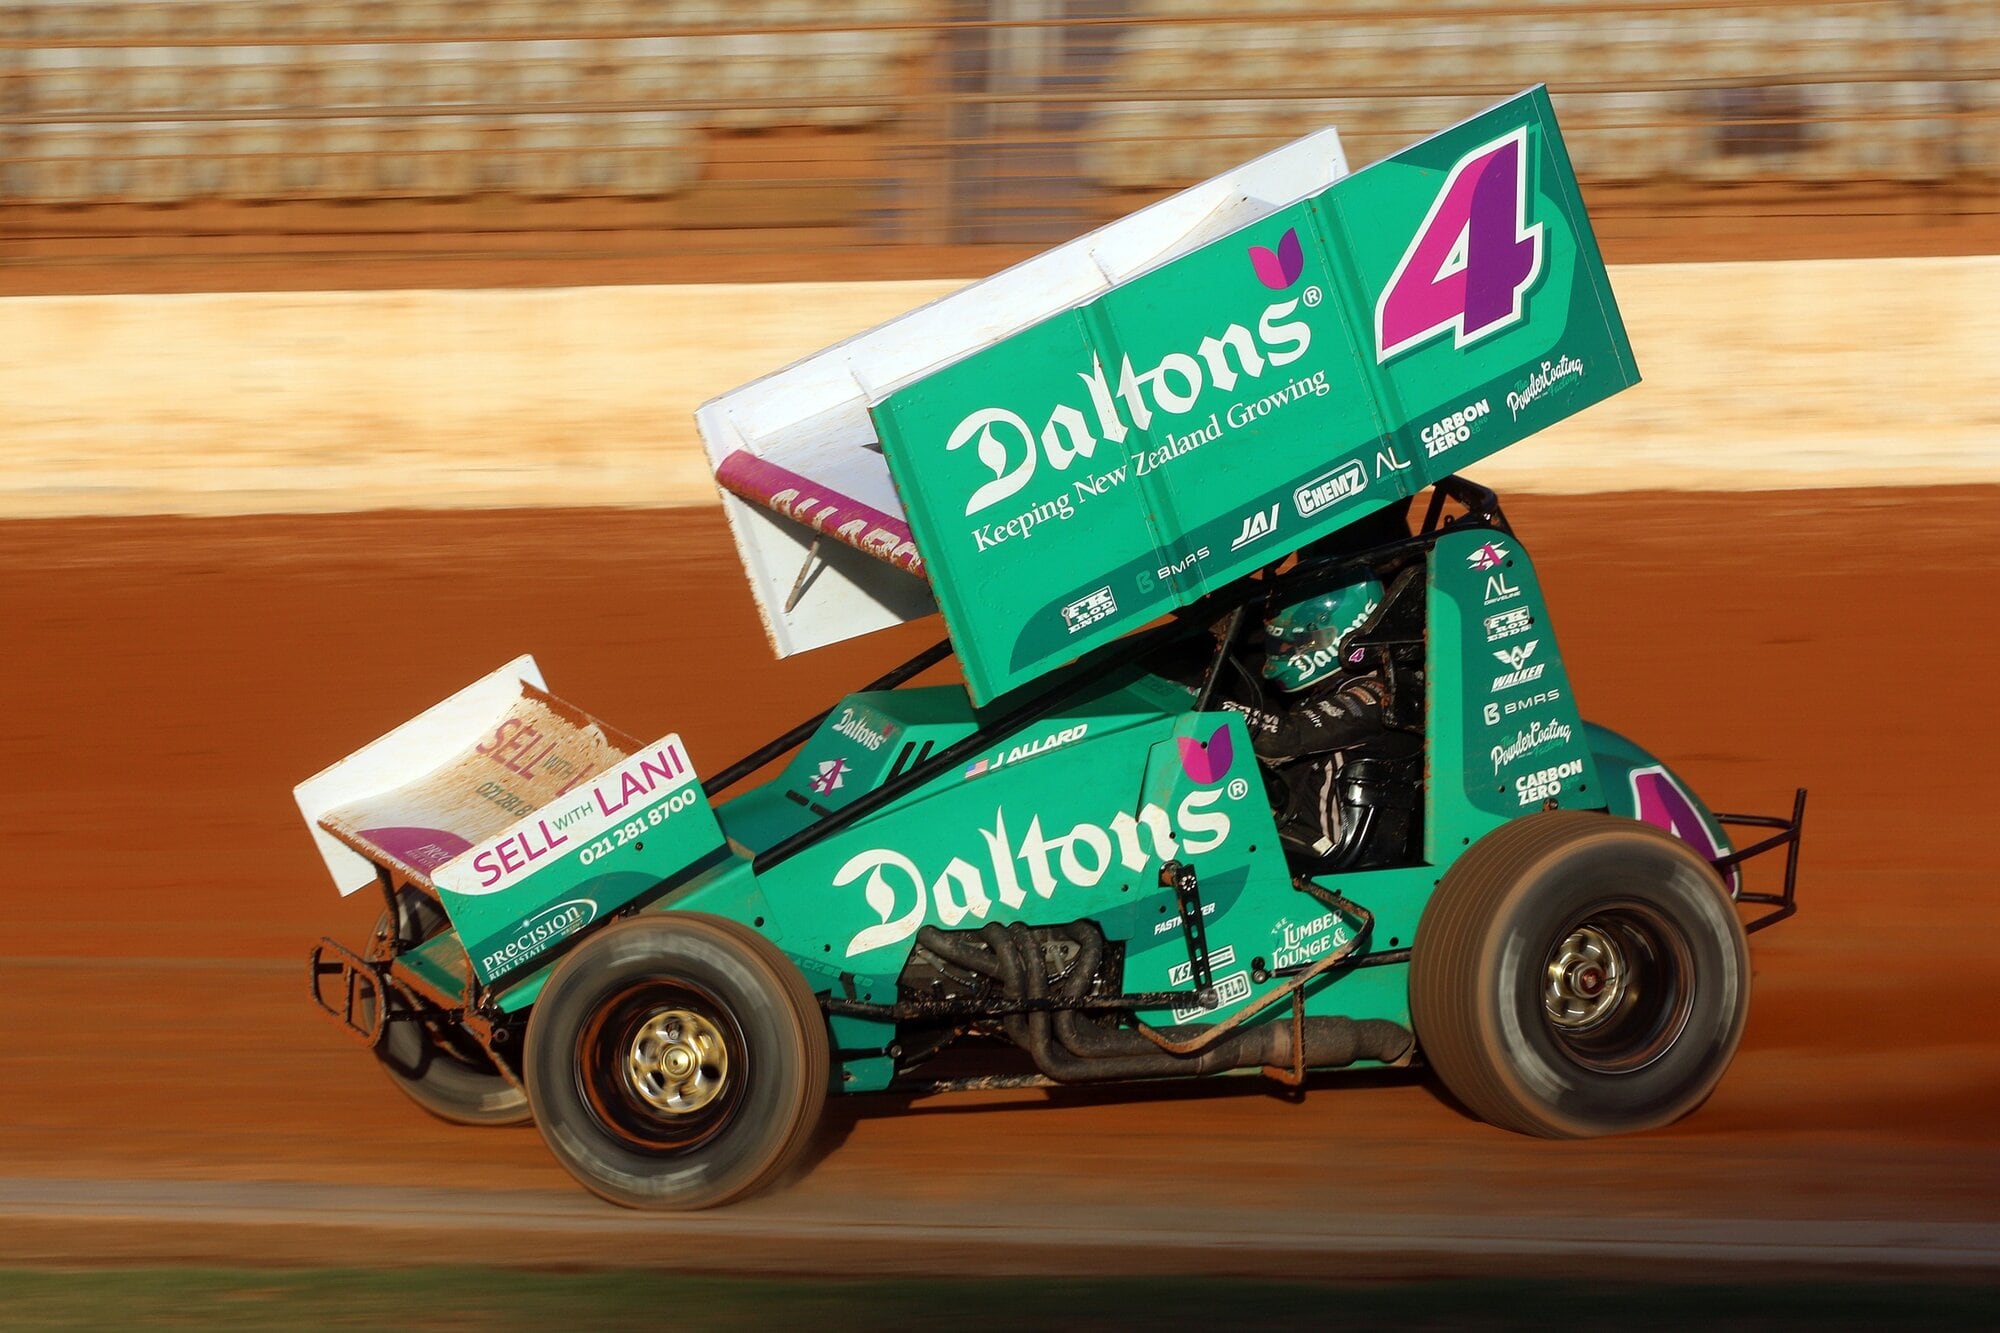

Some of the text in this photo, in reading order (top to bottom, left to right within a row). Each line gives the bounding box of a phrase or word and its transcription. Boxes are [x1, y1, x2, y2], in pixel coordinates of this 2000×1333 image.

[1375, 125, 1543, 365] 4
[1420, 398, 1491, 444] CARBON
[1425, 426, 1471, 459] ZERO
[971, 370, 1331, 552] Keeping New Zealand Growing
[1299, 467, 1366, 513] CHEMZ
[1157, 546, 1211, 580] BMRS
[1068, 606, 1117, 634] ENDS
[1069, 588, 1111, 619] FK
[1077, 601, 1115, 623] ROD
[1490, 663, 1545, 690] WALKER
[1504, 688, 1560, 715] BMRS
[990, 724, 1089, 771] J ALLARD
[1516, 759, 1583, 792] CARBON
[1518, 781, 1561, 806] ZERO
[473, 819, 568, 887] SELL
[552, 801, 594, 831] WITH
[593, 744, 685, 818] LANI
[579, 788, 697, 867] 021 281 8700
[1271, 916, 1288, 935] THE
[1283, 911, 1343, 952] LUMBER
[488, 944, 547, 981] REAL ESTATE
